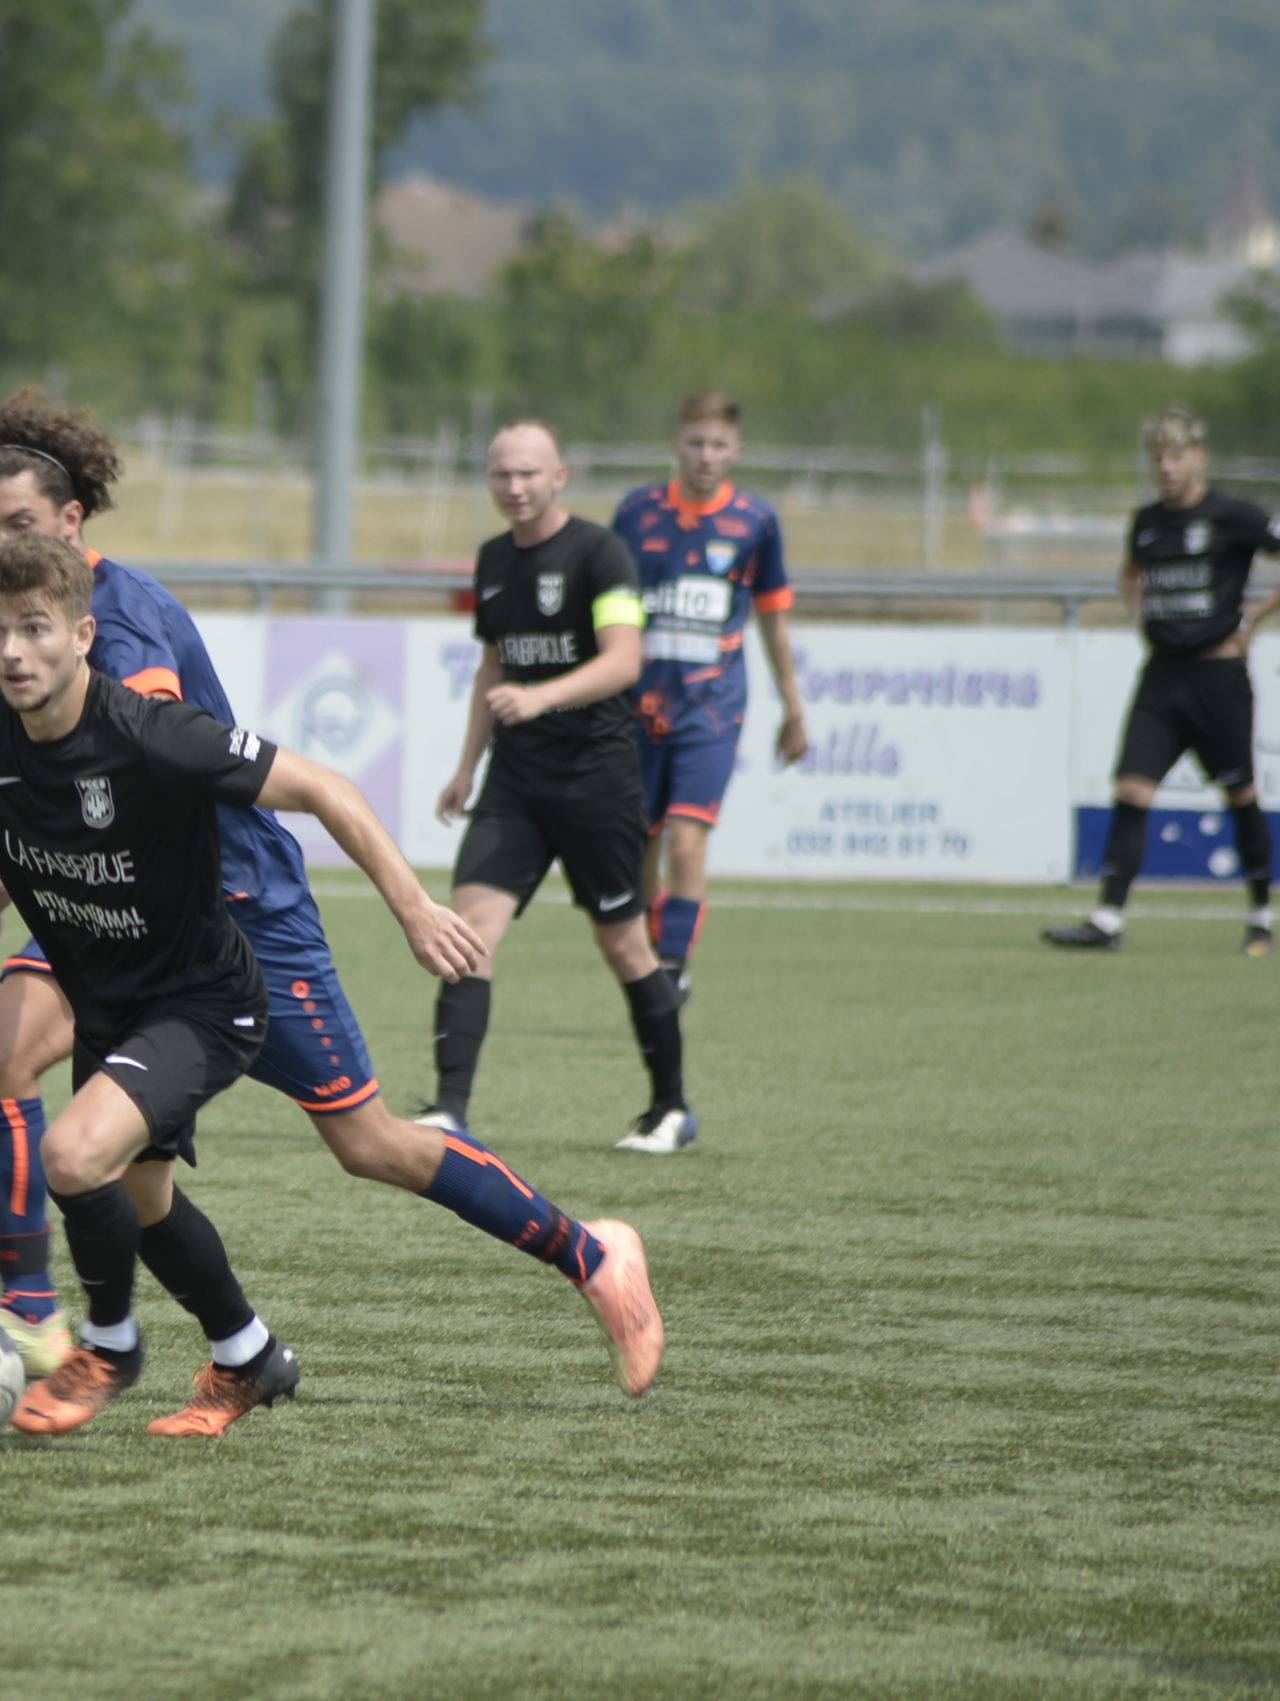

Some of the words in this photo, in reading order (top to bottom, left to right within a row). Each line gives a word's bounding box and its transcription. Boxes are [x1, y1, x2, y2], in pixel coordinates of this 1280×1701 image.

[819, 800, 939, 827] ATELIER
[5, 829, 33, 871] LA
[28, 846, 136, 886] FABRIQUE
